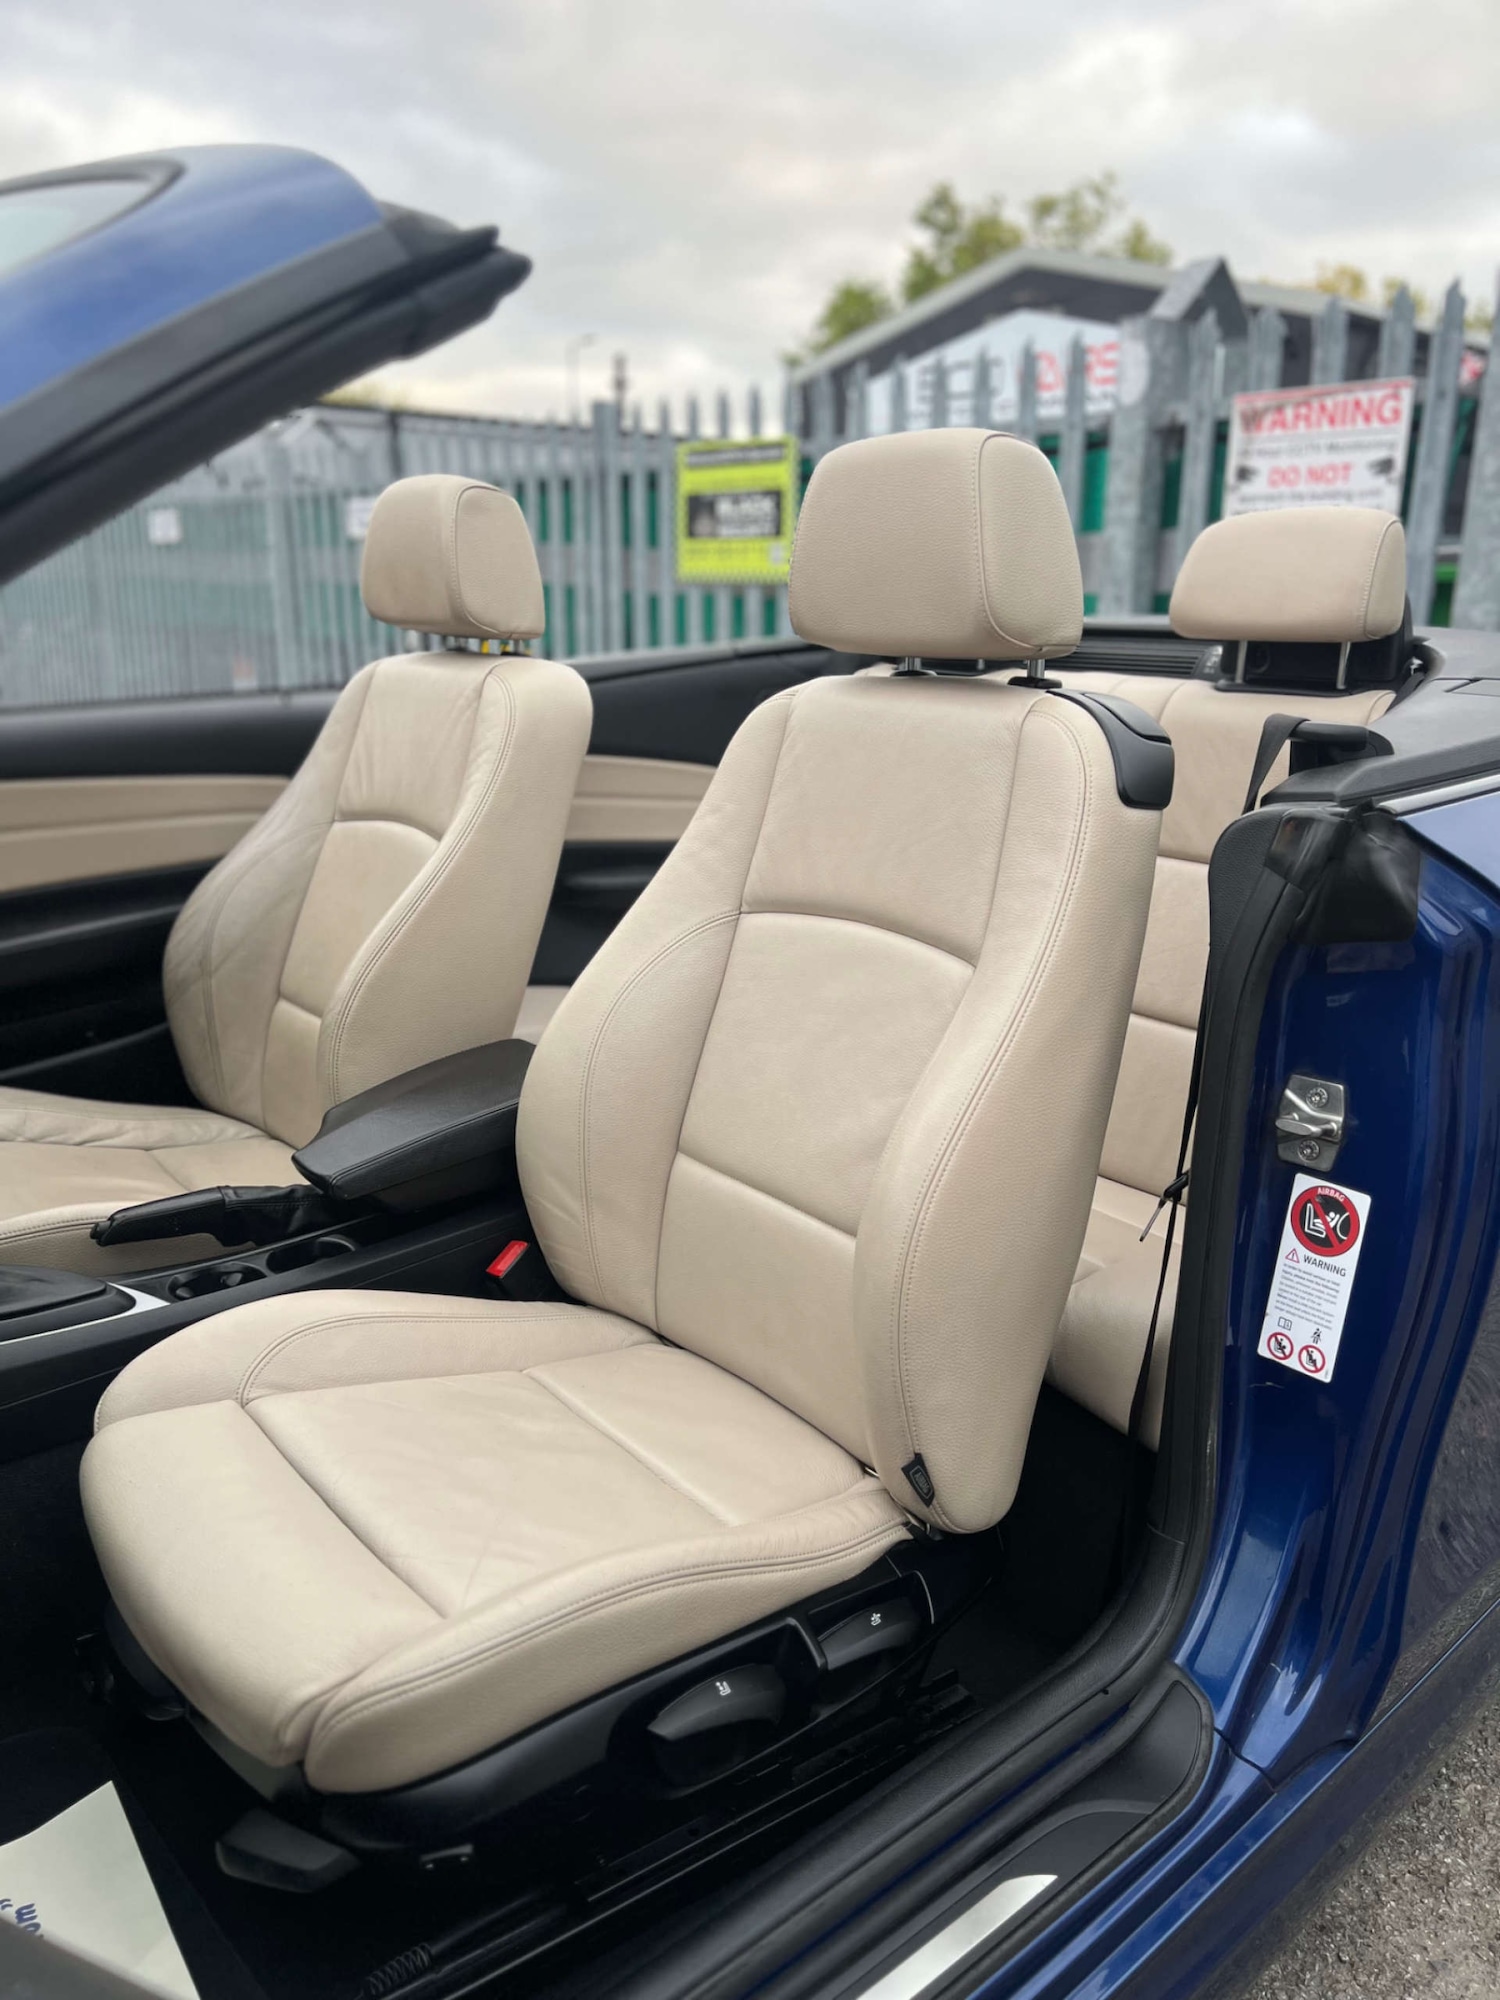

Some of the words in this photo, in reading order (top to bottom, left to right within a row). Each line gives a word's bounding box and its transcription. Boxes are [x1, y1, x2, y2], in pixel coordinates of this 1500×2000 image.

[1240, 392, 1402, 433] WARNING
[1267, 465, 1301, 489] DO
[1305, 462, 1353, 487] NOT
[1317, 1186, 1345, 1202] AIRBAG
[1303, 1254, 1347, 1277] WARNING
